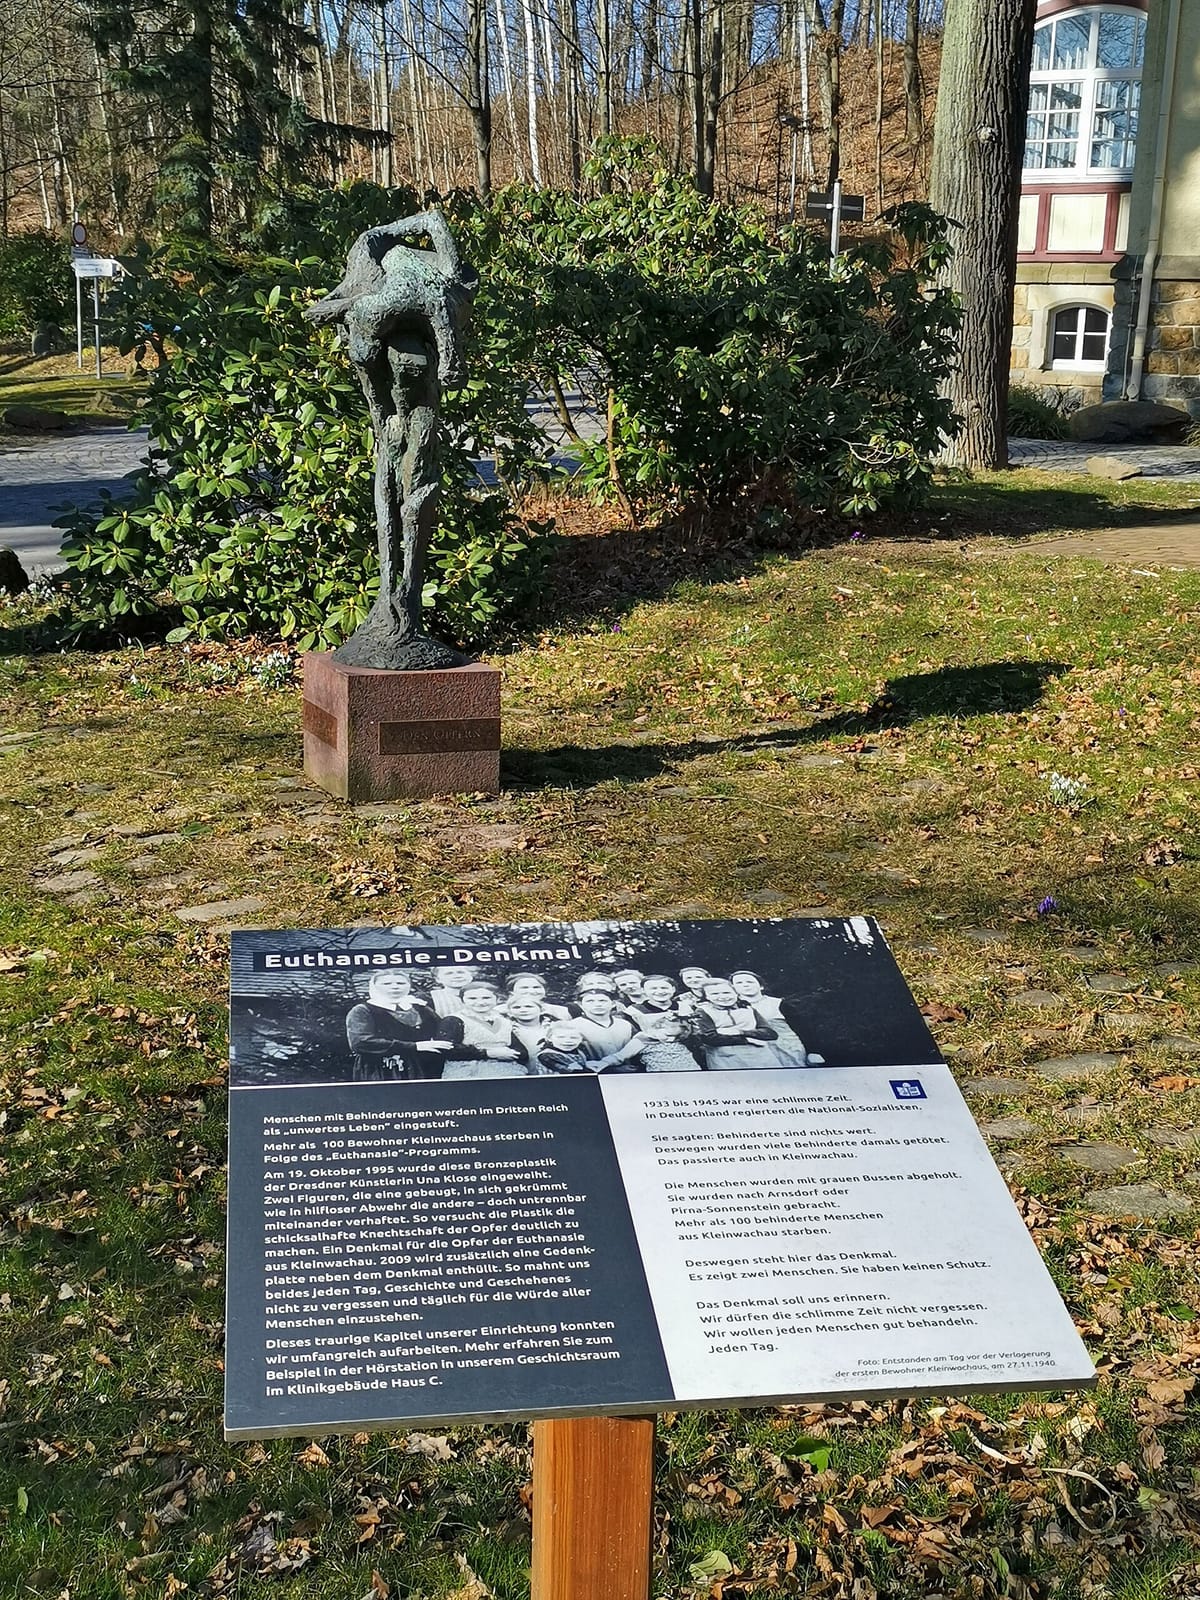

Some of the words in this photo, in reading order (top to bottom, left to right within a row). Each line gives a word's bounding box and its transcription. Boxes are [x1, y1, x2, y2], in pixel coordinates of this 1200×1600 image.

[265, 949, 430, 968] Euthanasie
[453, 945, 582, 963] Denkmal
[643, 1100, 670, 1108] 1933
[672, 1099, 689, 1107] bis
[692, 1098, 719, 1106] 1945
[771, 1096, 823, 1104] schlimme
[825, 1094, 852, 1102] Zeit.
[263, 1114, 321, 1124] Menschen
[324, 1112, 344, 1121] mit
[345, 1110, 432, 1121] Behinderungen
[434, 1107, 477, 1117] werden
[479, 1107, 493, 1115] im
[495, 1105, 536, 1114] Dritten
[537, 1103, 568, 1112] Reich
[658, 1109, 730, 1119] Deutschland
[732, 1108, 786, 1117] regierten
[807, 1103, 922, 1113] National-Sozialisten.
[263, 1127, 281, 1136] als
[393, 1119, 459, 1130] eingestuft.
[651, 1134, 669, 1142] Sie
[671, 1133, 714, 1142] sagten:
[716, 1131, 780, 1139] Behinderte
[783, 1129, 807, 1137] sind
[809, 1128, 844, 1136] nichts
[845, 1127, 876, 1135] wert.
[263, 1142, 296, 1151] Mehr
[298, 1141, 316, 1149] als
[322, 1139, 344, 1148] 100
[347, 1137, 408, 1147] Bewohner
[411, 1133, 492, 1144] Kleinwachaus
[494, 1131, 540, 1141] sterben
[542, 1130, 554, 1139] in
[654, 1145, 715, 1153] Deswegen
[717, 1143, 761, 1151] wurden
[762, 1141, 791, 1149] viele
[793, 1139, 857, 1148] Behinderte
[860, 1137, 901, 1146] damals
[902, 1136, 950, 1146] getötet.
[263, 1154, 298, 1164] Folge
[301, 1152, 323, 1161] des
[263, 1171, 284, 1179] Am
[288, 1169, 307, 1178] 19.
[309, 1167, 362, 1177] Oktober
[364, 1165, 394, 1174] 1995
[397, 1163, 436, 1173] wurde
[438, 1162, 471, 1171] diese
[473, 1157, 557, 1170] Bronzeplastik
[263, 1183, 286, 1192] der
[288, 1180, 347, 1191] Dresdner
[349, 1176, 413, 1188] Künstlerin
[416, 1176, 440, 1184] Una
[443, 1174, 477, 1183] Klose
[479, 1170, 552, 1182] eingeweiht.
[664, 1181, 684, 1190] Die
[687, 1179, 747, 1189] Menschen
[749, 1177, 794, 1186] wurden
[796, 1176, 817, 1184] mit
[819, 1176, 860, 1185] grauen
[862, 1174, 904, 1182] Bussen
[906, 1171, 962, 1181] abgeholt.
[670, 1202, 781, 1215] Pirna-Sonnenstein
[783, 1200, 840, 1211] gebracht.
[674, 1218, 706, 1227] Mehr
[709, 1217, 726, 1226] als
[729, 1217, 751, 1225] 100
[753, 1214, 820, 1224] behinderte
[823, 1211, 884, 1221] Menschen
[264, 1230, 356, 1244] schicksalhafte
[359, 1225, 444, 1239] Knechtschaft
[446, 1225, 468, 1234] der
[470, 1223, 508, 1234] Opfer
[510, 1220, 562, 1231] deutlich
[678, 1233, 699, 1241] aus
[701, 1229, 778, 1239] Kleinwachau
[780, 1227, 831, 1236] starben.
[684, 1258, 749, 1267] Deswegen
[752, 1255, 785, 1264] steht
[787, 1254, 812, 1263] hier
[815, 1253, 837, 1261] das
[838, 1250, 897, 1260] Denkmal.
[264, 1275, 306, 1287] platte
[309, 1272, 350, 1283] neben
[353, 1270, 382, 1280] dem
[385, 1266, 443, 1279] Denkmal
[445, 1263, 502, 1275] enthüllt.
[504, 1263, 521, 1272] So
[523, 1260, 565, 1271] mahnt
[567, 1260, 590, 1269] uns
[265, 1288, 310, 1300] beides
[311, 1286, 350, 1299] jeden
[352, 1285, 381, 1295] Tag,
[384, 1280, 456, 1293] Geschichte
[458, 1278, 484, 1289] und
[486, 1275, 572, 1287] Geschehenes
[695, 1301, 720, 1309] Das
[722, 1296, 780, 1308] Denkmal
[781, 1295, 805, 1305] soll
[807, 1296, 830, 1304] uns
[832, 1293, 890, 1303] erinnern.
[265, 1316, 334, 1329] Menschen
[337, 1311, 423, 1325] einzustehen.
[699, 1314, 722, 1323] Wir
[725, 1312, 769, 1323] dürfen
[771, 1311, 792, 1320] die
[794, 1309, 855, 1319] schlimme
[856, 1306, 883, 1316] Zeit
[885, 1305, 918, 1314] nicht
[919, 1303, 988, 1313] vergessen.
[265, 1338, 311, 1349] Dieses
[314, 1334, 370, 1346] traurige
[373, 1330, 423, 1343] Kapitel
[425, 1328, 478, 1339] unserer
[480, 1324, 557, 1336] Einrichtung
[559, 1320, 615, 1331] konnten
[708, 1343, 748, 1354] Jeden
[749, 1342, 779, 1352] Tag.
[266, 1366, 321, 1380] Beispiel
[323, 1366, 336, 1376] in
[339, 1365, 363, 1375] der
[365, 1360, 438, 1374] Hörstation
[440, 1359, 454, 1369] in
[456, 1357, 515, 1368] unserem
[516, 1351, 620, 1364] Geschichtsraum
[882, 1356, 932, 1365] Entstanden
[948, 1354, 964, 1362] Tag
[998, 1351, 1051, 1359] Verlagerung
[835, 1370, 850, 1378] der
[852, 1368, 880, 1377] ersten
[881, 1366, 925, 1375] Bewohner
[266, 1385, 283, 1396] im
[287, 1378, 388, 1395] Klinikgebäude
[391, 1378, 426, 1388] Haus
[428, 1375, 443, 1385] C.
